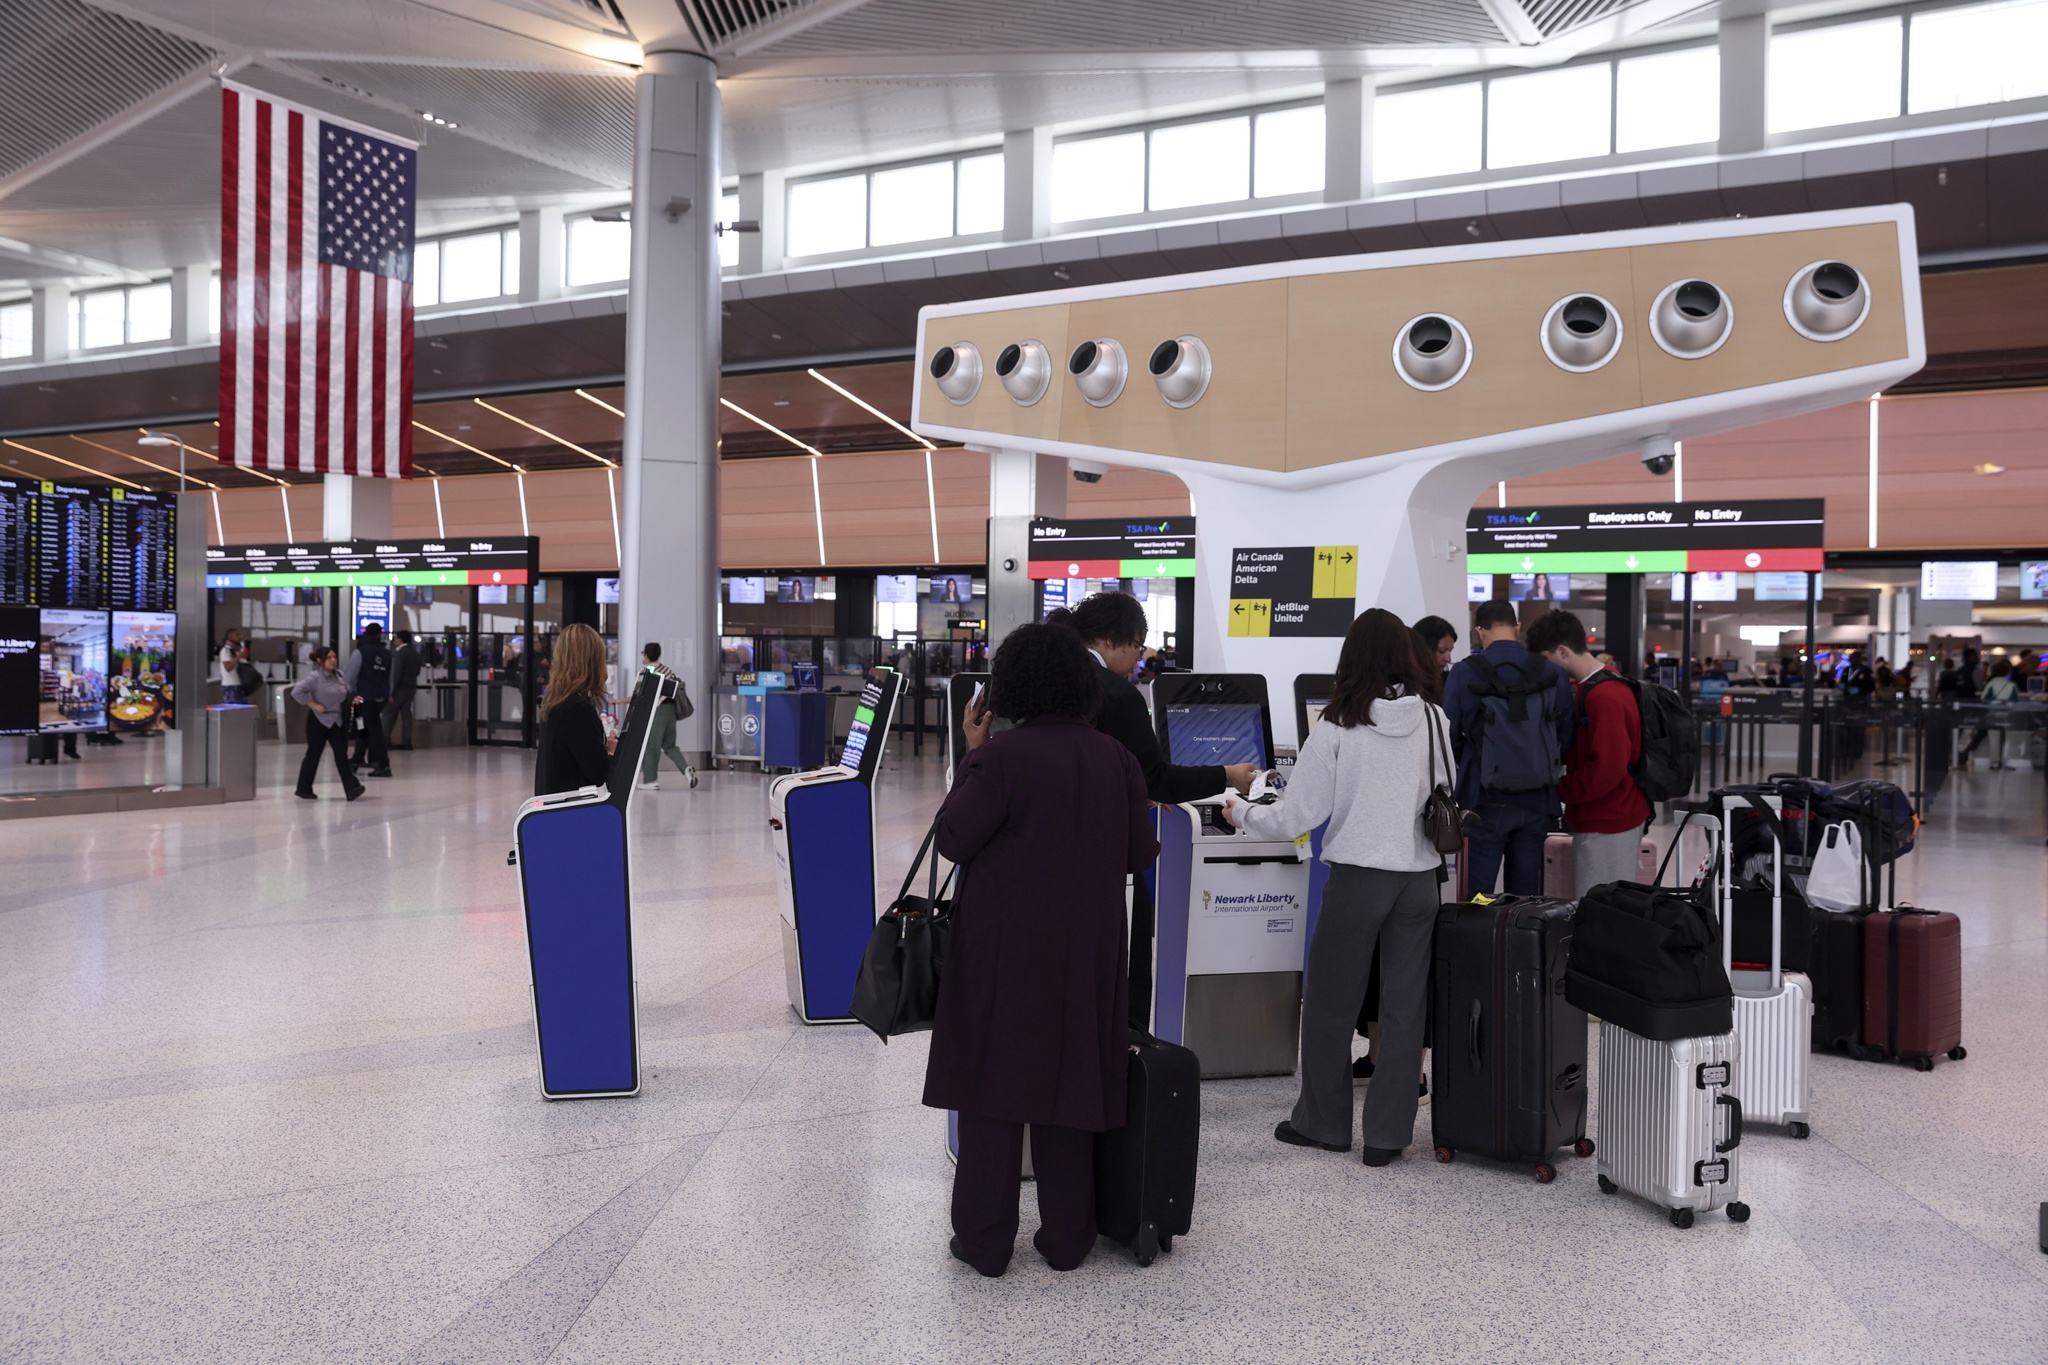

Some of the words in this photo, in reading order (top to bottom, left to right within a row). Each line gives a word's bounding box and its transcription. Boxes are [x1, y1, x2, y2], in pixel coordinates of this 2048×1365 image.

[56, 485, 90, 495] Departures
[126, 492, 157, 501] Departures
[1487, 515, 1507, 525] TSA
[1588, 512, 1646, 524] Employees
[1647, 511, 1673, 524] Only
[1695, 510, 1711, 520] No
[1712, 509, 1743, 521] Entry
[1034, 528, 1044, 536] No
[1046, 527, 1066, 537] Entry
[1126, 525, 1143, 533] TSA
[432, 544, 446, 552] Gates
[470, 543, 478, 551] No
[478, 542, 493, 552] Entry
[1235, 553, 1249, 562] Air
[1250, 552, 1284, 562] Canada
[1235, 564, 1277, 573] American
[1235, 575, 1258, 584] Delta
[1274, 602, 1310, 612] JetBlue
[944, 610, 975, 618] audible
[1274, 613, 1304, 623] United
[6, 639, 36, 649] Liberty
[1742, 696, 1757, 704] Entry
[1214, 894, 1255, 904] Newark
[1257, 893, 1295, 905] Liberty
[1214, 904, 1259, 913] International
[1260, 904, 1284, 913] Airport
